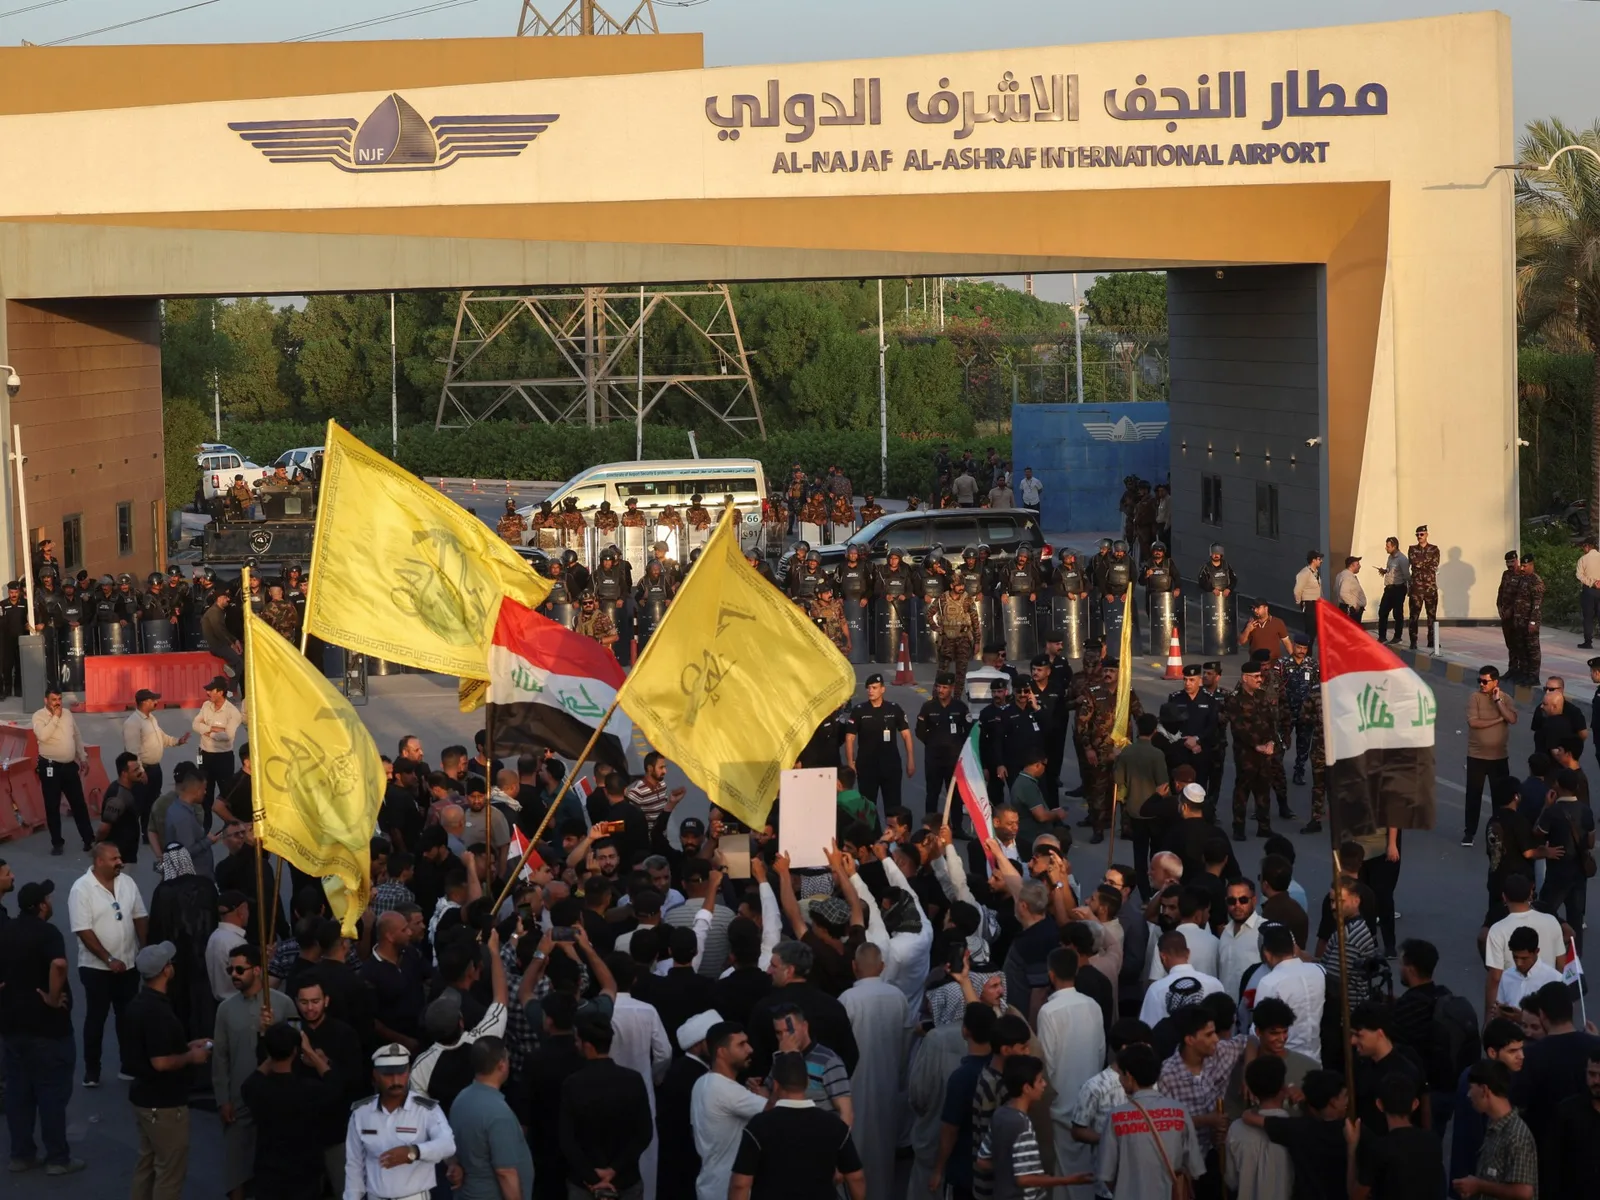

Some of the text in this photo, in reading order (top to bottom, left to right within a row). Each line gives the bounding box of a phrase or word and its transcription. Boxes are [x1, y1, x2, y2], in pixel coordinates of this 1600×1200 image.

[705, 69, 1388, 142] مطار النجف الاشرف الدولي
[359, 148, 384, 161] NJF
[772, 141, 1330, 174] AL-NAJAF AL-ASHRAF INTERNATIONAL AIRPORT
[747, 515, 759, 523] 66
